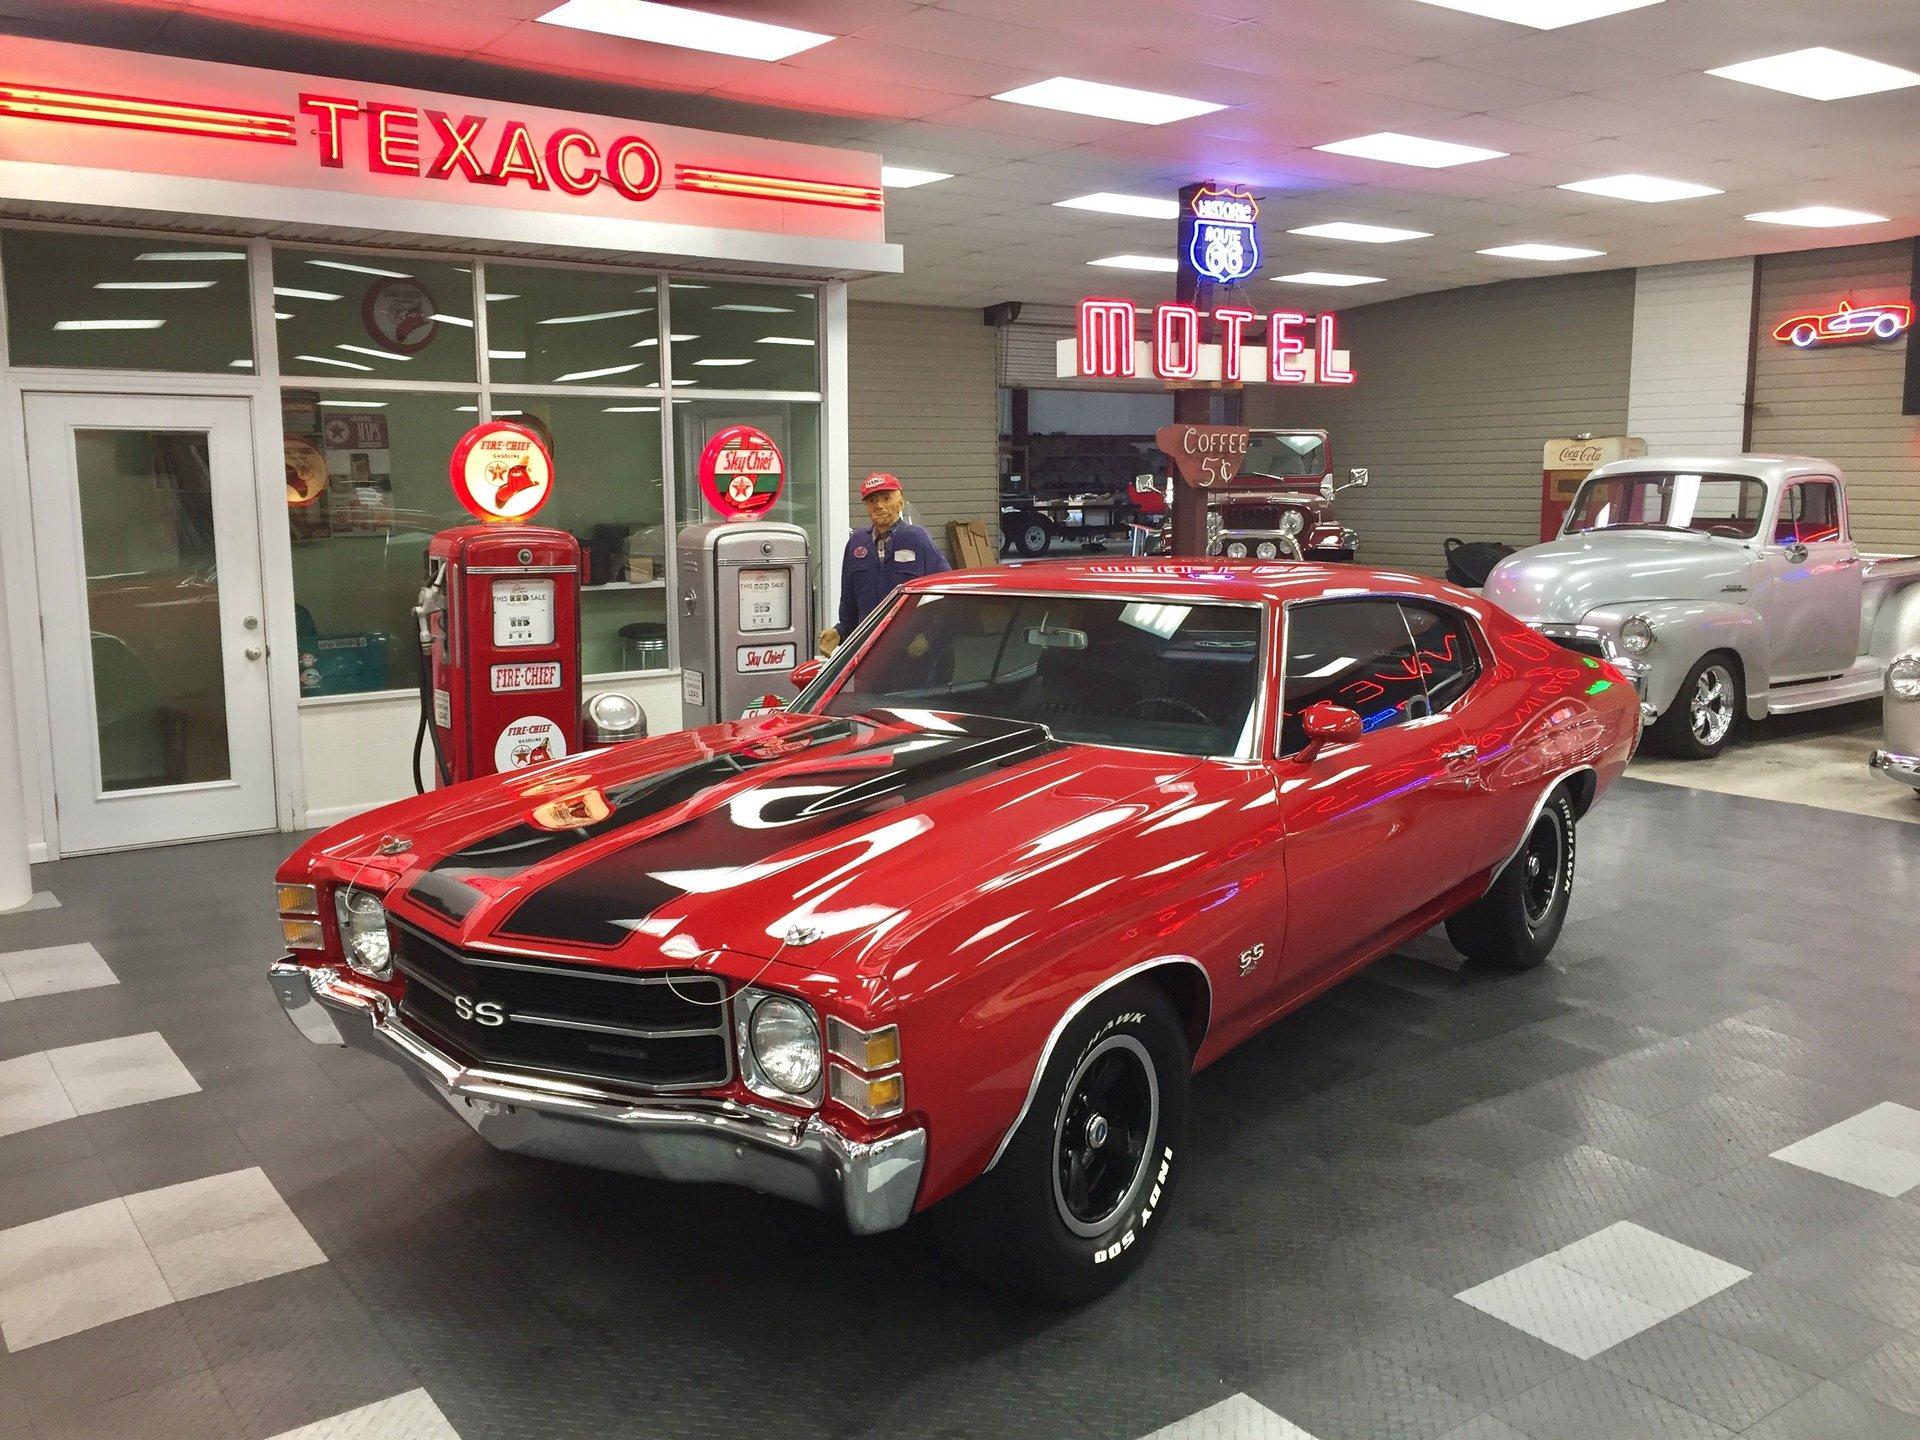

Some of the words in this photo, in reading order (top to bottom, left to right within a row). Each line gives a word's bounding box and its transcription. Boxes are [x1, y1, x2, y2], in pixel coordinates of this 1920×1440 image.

[299, 93, 662, 202] TEXACO
[1205, 226, 1242, 243] ROUTE
[1206, 241, 1243, 275] 66
[1076, 297, 1357, 384] MOTEL
[724, 450, 747, 473] Sky
[747, 450, 774, 470] Chief
[1199, 457, 1232, 487] 5¢
[746, 651, 761, 667] Sky
[763, 649, 786, 664] Chief
[1239, 943, 1264, 969] SS
[454, 996, 504, 1027] SS
[1141, 1146, 1173, 1228] INDY
[1094, 1229, 1136, 1264] 500
